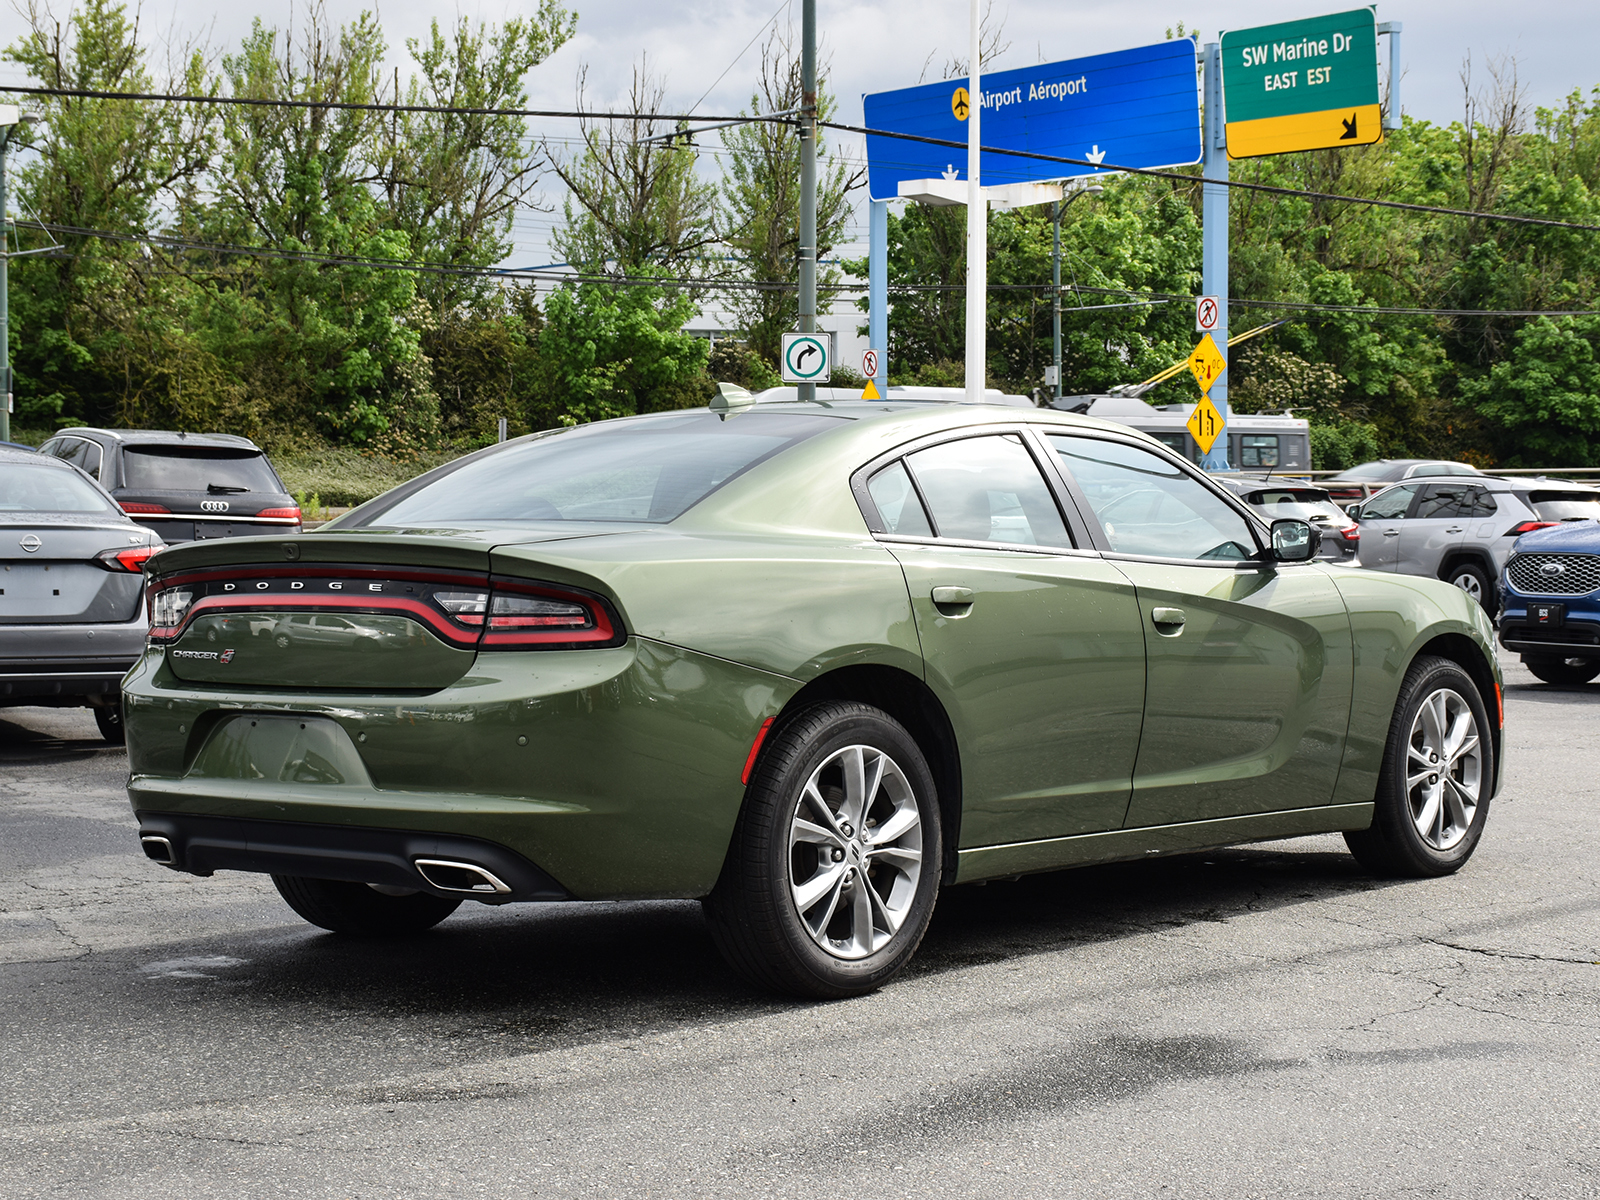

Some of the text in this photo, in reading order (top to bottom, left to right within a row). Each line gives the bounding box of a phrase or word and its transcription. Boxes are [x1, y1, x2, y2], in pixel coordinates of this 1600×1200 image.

[1242, 32, 1353, 68] SW Marine Dr
[1264, 66, 1332, 92] EAST EST
[979, 75, 1088, 112] Airport Aéroport
[223, 581, 384, 592] DODGE
[172, 650, 219, 660] CHARGER
